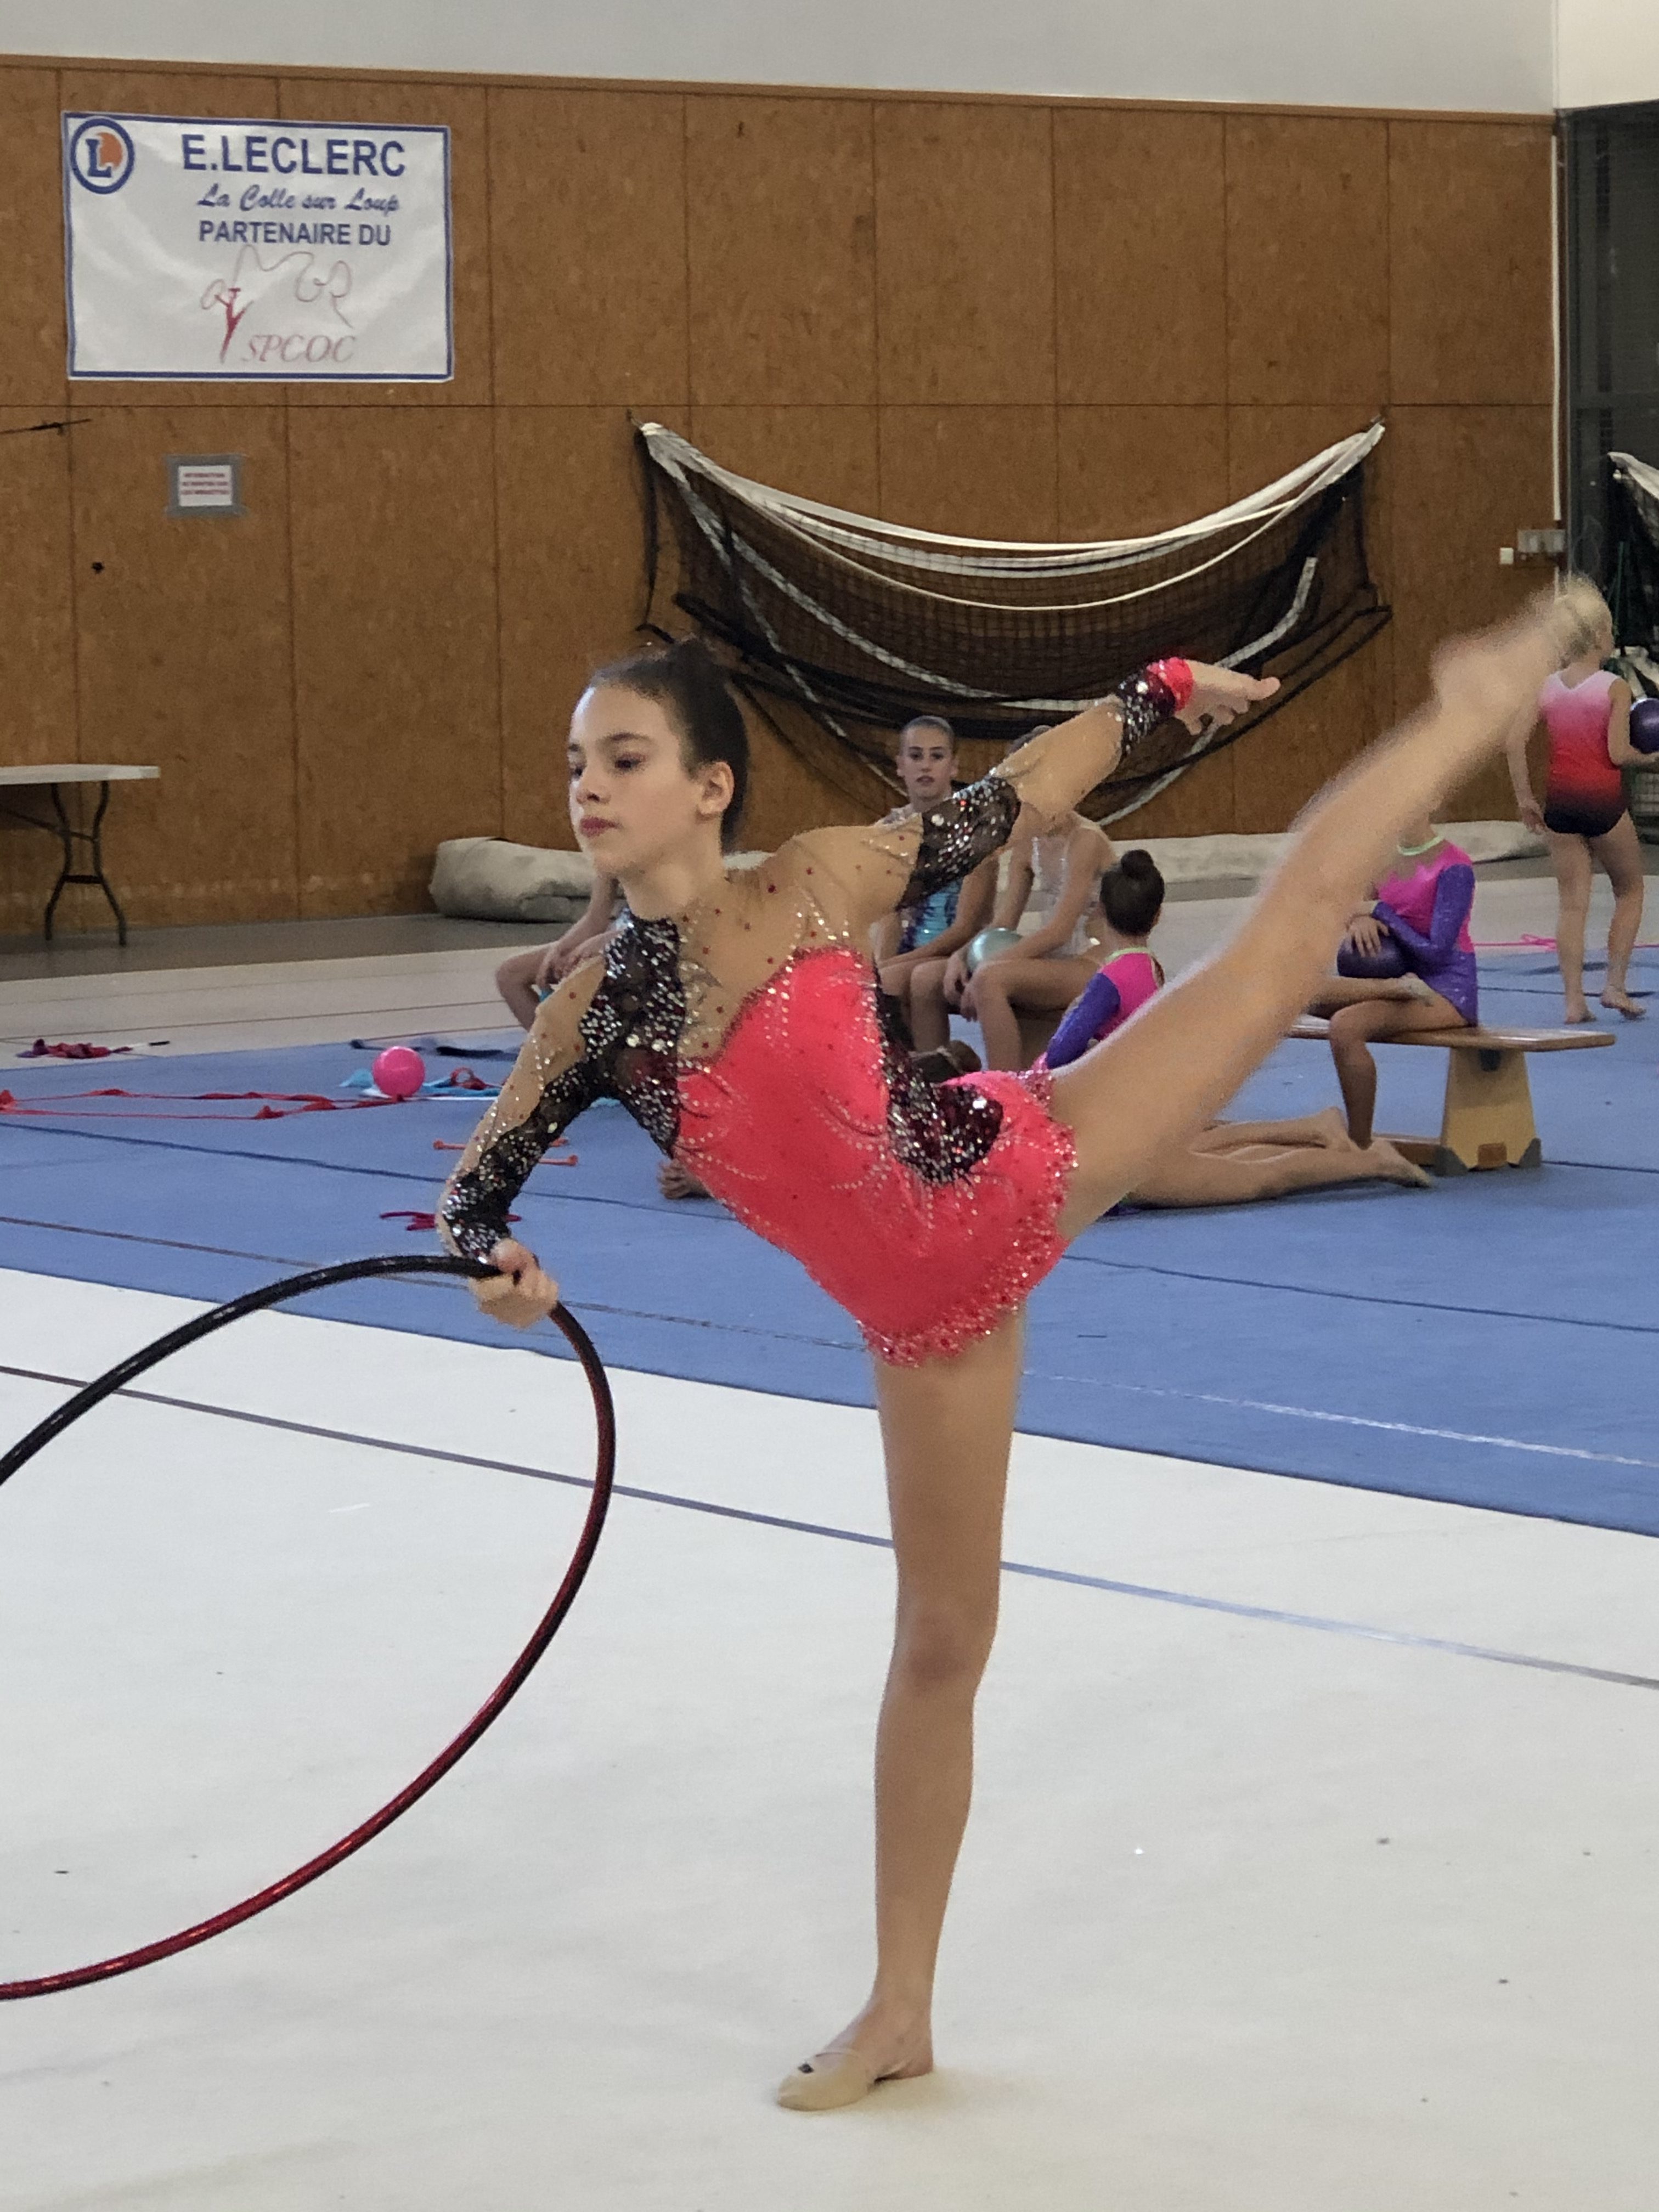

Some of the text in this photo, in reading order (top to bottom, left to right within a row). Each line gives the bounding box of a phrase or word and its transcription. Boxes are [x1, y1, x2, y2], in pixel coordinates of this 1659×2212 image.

[182, 134, 405, 176] E.LECLERC
[197, 183, 400, 217] La Colle sur Loup
[199, 220, 391, 246] PARTENAIRE DU
[241, 334, 357, 363] SPCOC
